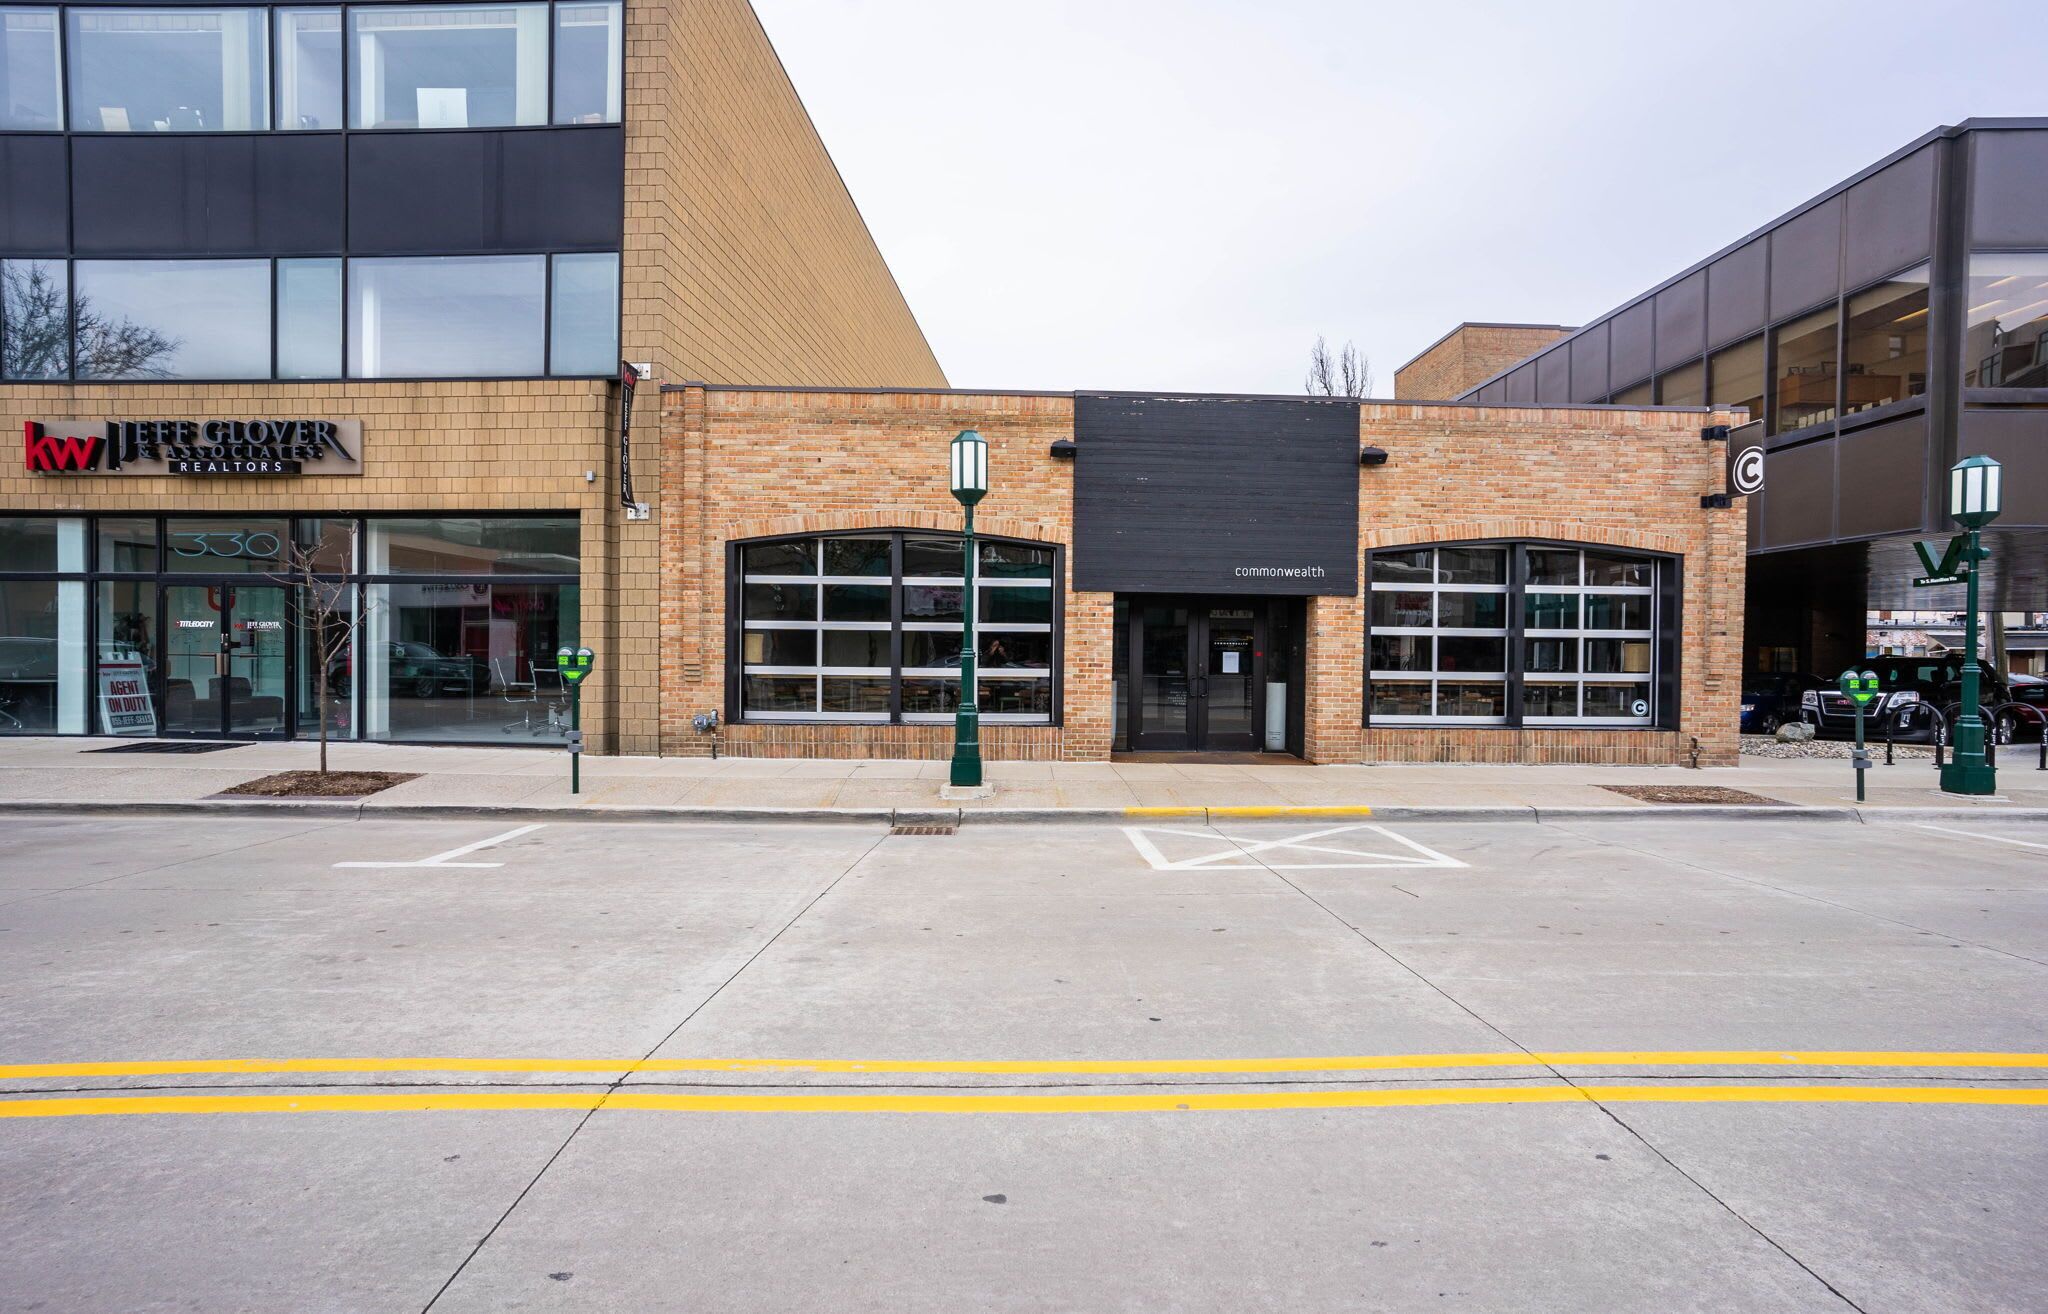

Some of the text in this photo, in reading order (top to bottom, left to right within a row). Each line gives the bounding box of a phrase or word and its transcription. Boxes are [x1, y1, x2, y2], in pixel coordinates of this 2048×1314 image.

[25, 421, 97, 470] kw
[119, 420, 350, 461] JEFF GLOVER
[138, 444, 315, 459] & ASSOCIATES
[180, 462, 283, 472] REALTORS
[173, 532, 280, 556] 330
[1235, 566, 1325, 578] commonwealth
[110, 680, 140, 696] AGENT
[108, 696, 148, 713] ON DUTY
